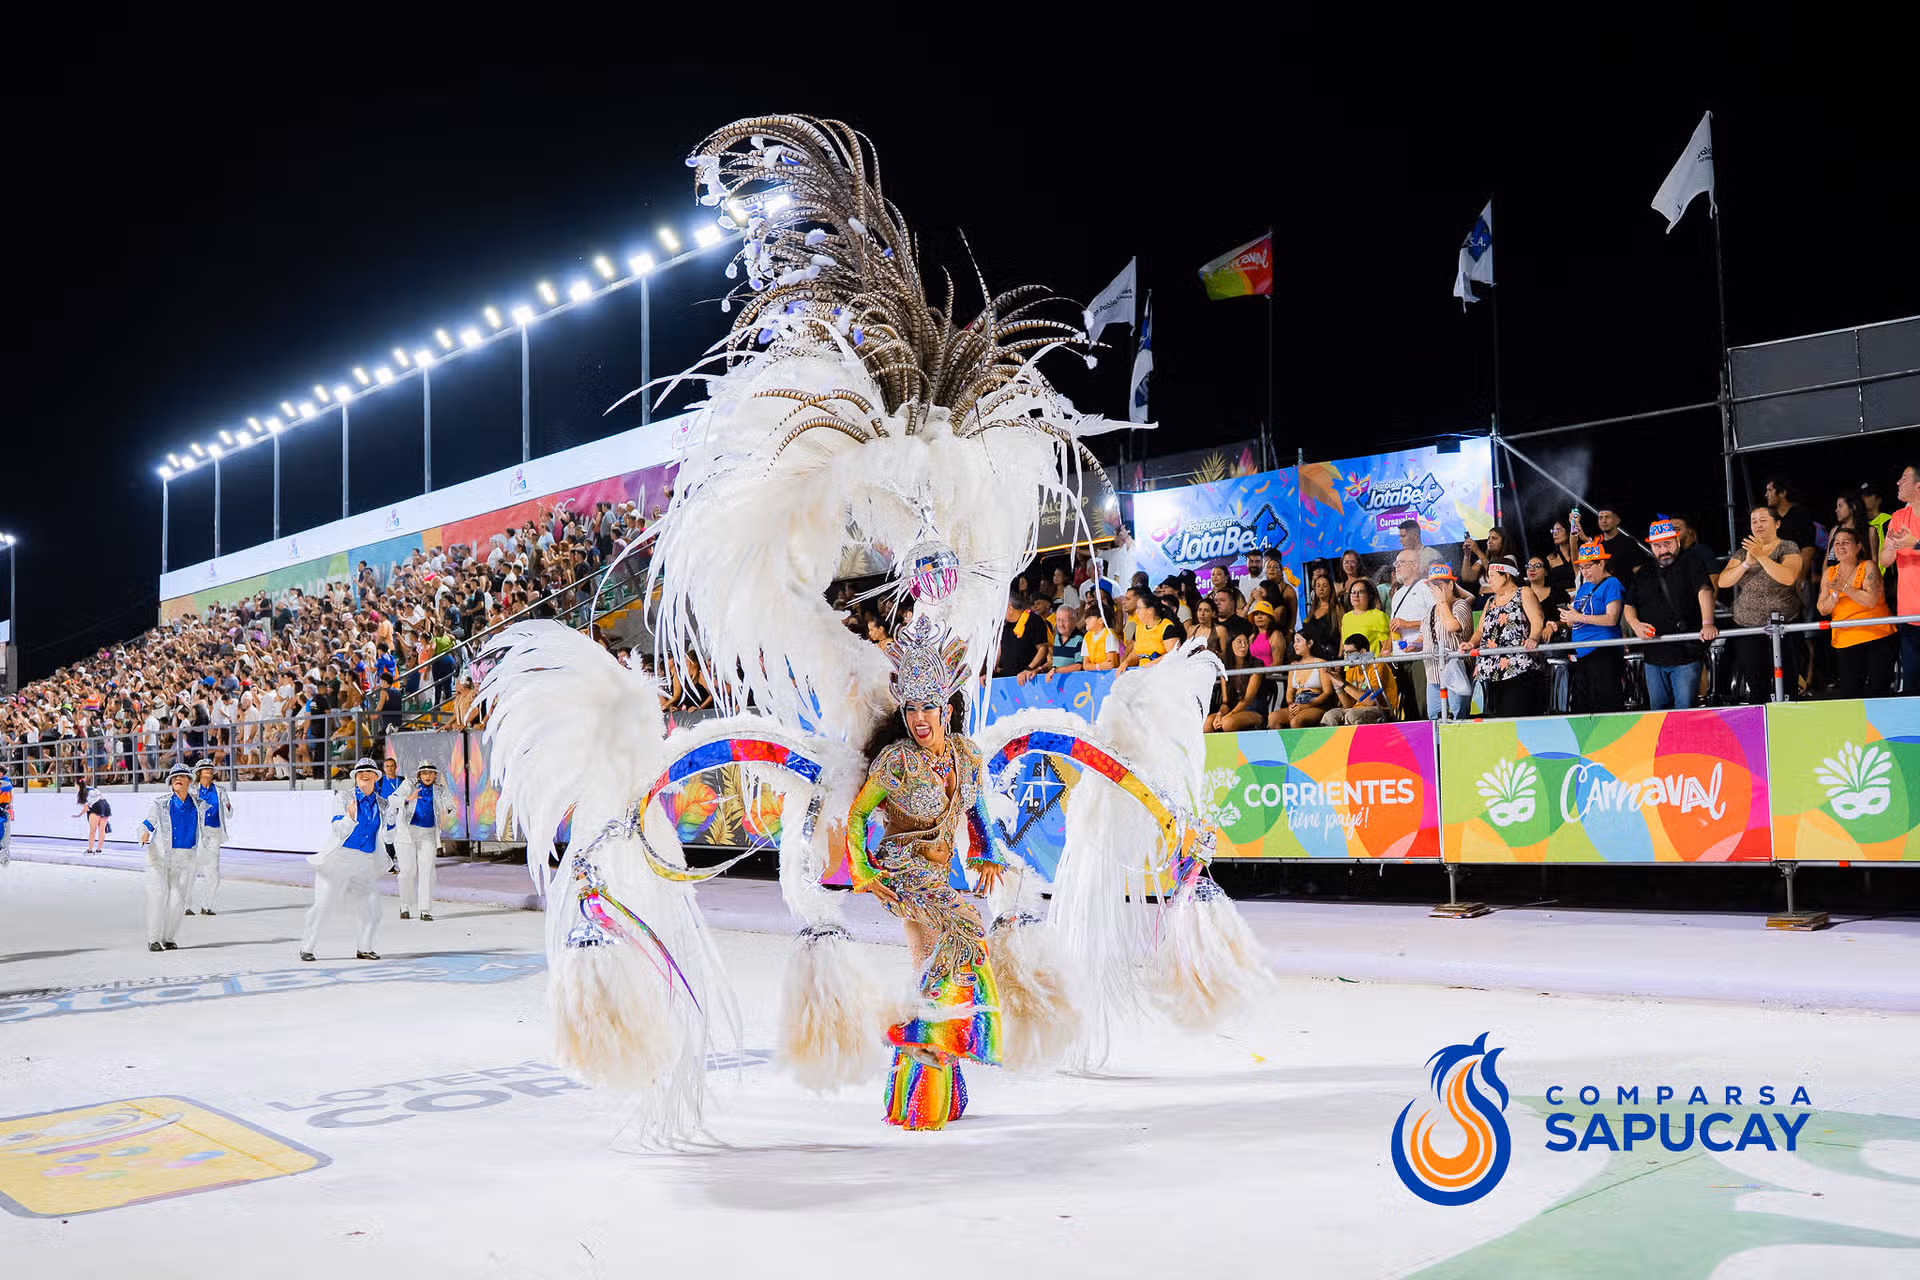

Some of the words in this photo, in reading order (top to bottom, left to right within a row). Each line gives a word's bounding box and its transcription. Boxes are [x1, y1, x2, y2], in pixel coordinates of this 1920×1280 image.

[1366, 486, 1421, 508] JotaBe
[1175, 526, 1255, 561] JotaBe
[1250, 535, 1272, 551] S.A.
[1007, 784, 1040, 808] SA.
[1244, 778, 1415, 808] CORRIENTES
[1286, 808, 1322, 831] tiene
[0, 965, 421, 1021] otaBe
[266, 1060, 561, 1112] LOTERÍ
